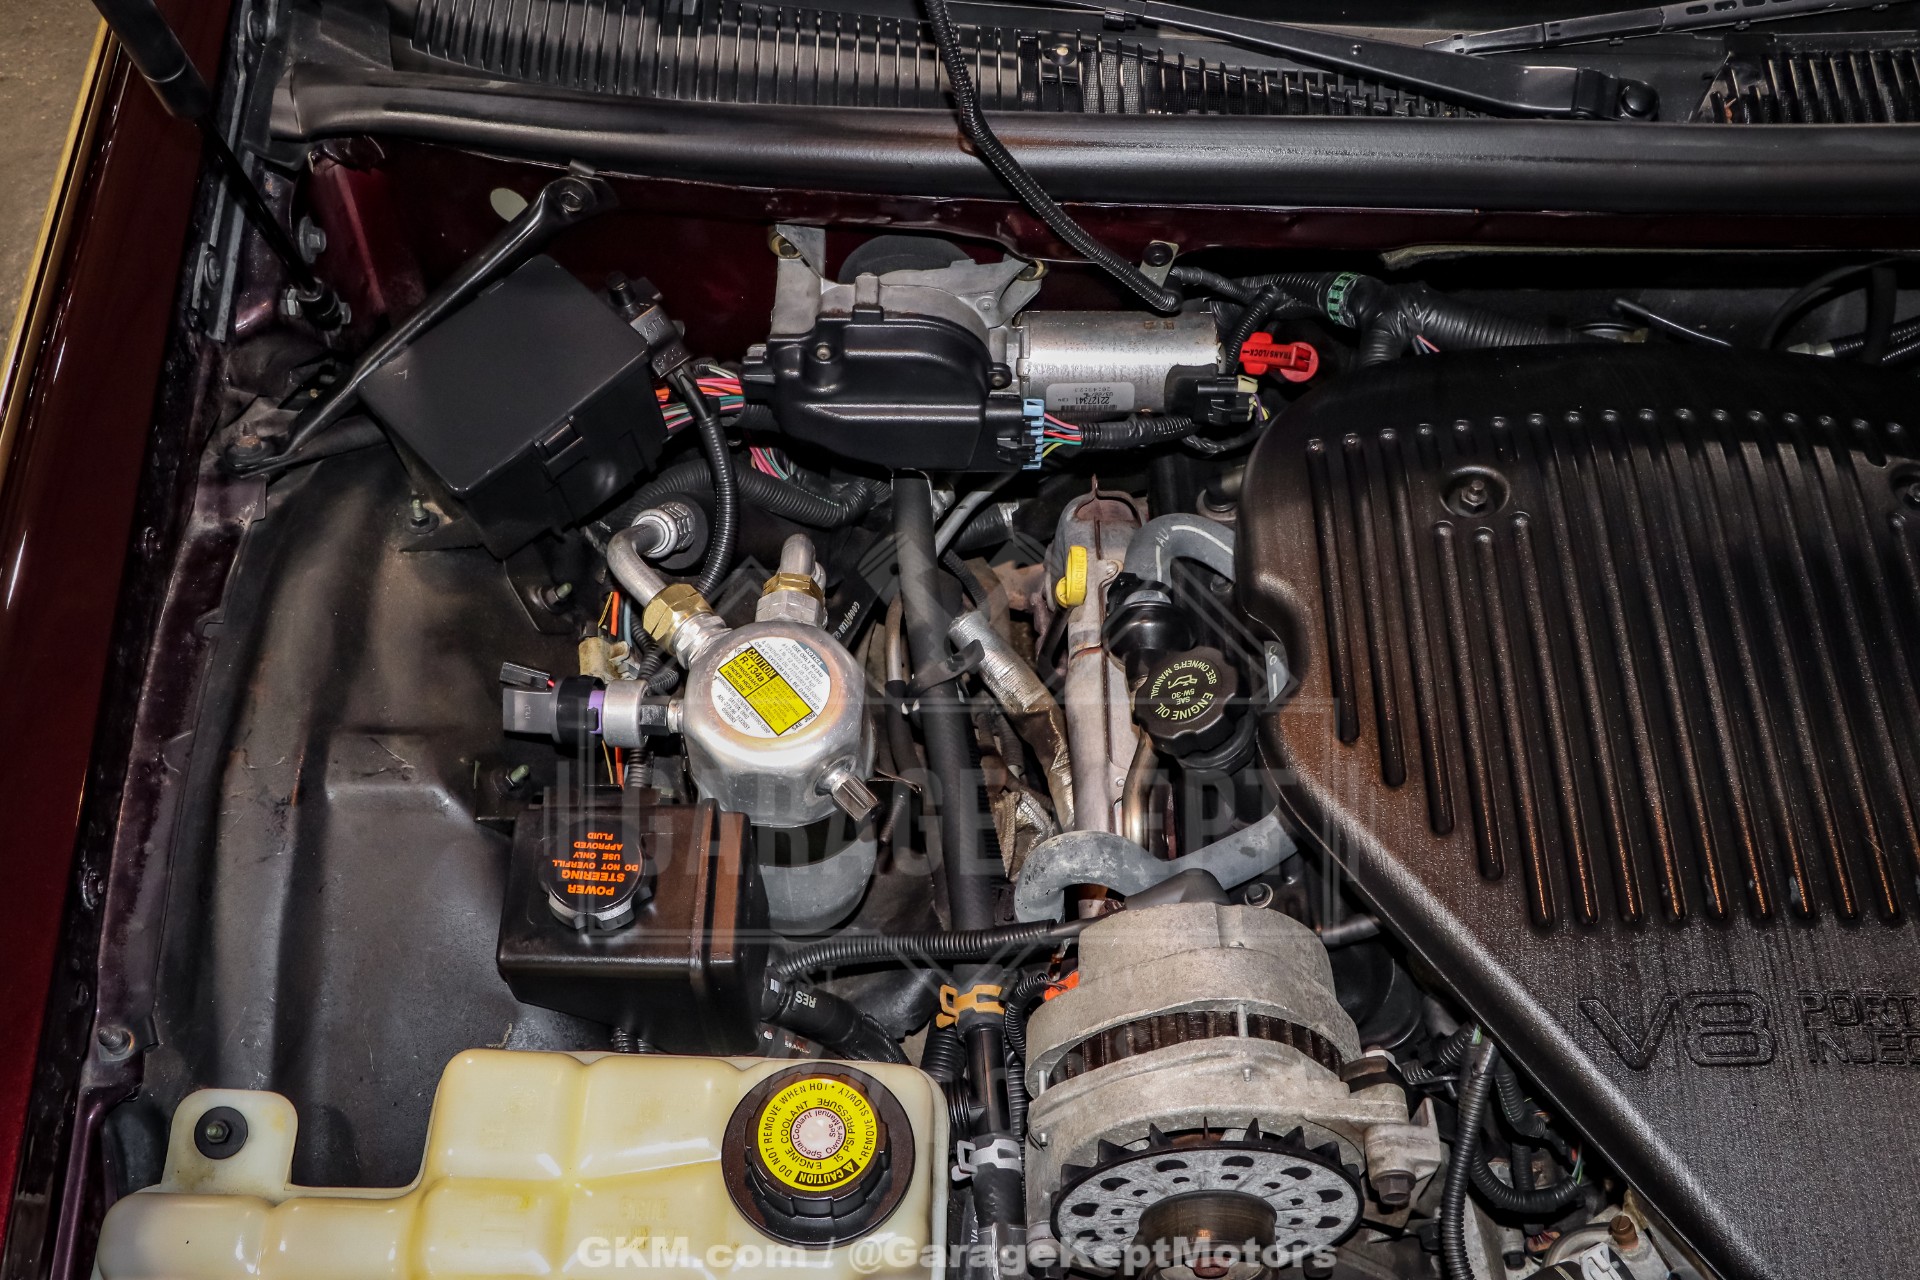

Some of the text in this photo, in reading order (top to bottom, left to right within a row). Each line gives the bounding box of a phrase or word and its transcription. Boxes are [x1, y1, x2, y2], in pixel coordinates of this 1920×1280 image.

[1074, 396, 1109, 404] 22127341
[747, 648, 776, 678] CAUTION
[806, 648, 823, 666] NOTICE
[733, 660, 759, 687] REFRIGERANT
[740, 655, 765, 682] R-134a
[1150, 659, 1217, 700] SEE OWNER'S MANUAL
[725, 670, 745, 692] PRESSURE
[1171, 688, 1195, 699] 5W-30
[1176, 696, 1191, 706] SAE
[1154, 692, 1214, 721] ENGINE OIL
[573, 841, 624, 851] APPROVED
[587, 832, 614, 840] FLUID
[552, 859, 639, 872] DO NOT OVERFILL
[573, 851, 621, 861] USE ONLY
[561, 869, 626, 883] STEERING
[567, 884, 615, 896] POWER
[794, 990, 818, 1009] RES
[1577, 990, 1918, 1071] V8 PORT
[778, 1083, 806, 1105] WHEN
[836, 1086, 870, 1117] SLOWLY
[762, 1104, 783, 1144] REMOVE
[791, 1111, 823, 1159] Special Coolant
[815, 1110, 843, 1154] See Owner's Manual
[816, 1097, 856, 1163] 15 PSI PRESSURE
[780, 1100, 823, 1171] ENGINE COOLANT
[859, 1117, 874, 1159] REMOVE
[765, 1145, 781, 1166] NOT
[778, 1164, 793, 1178] DO
[797, 1168, 845, 1185] CAUTION
